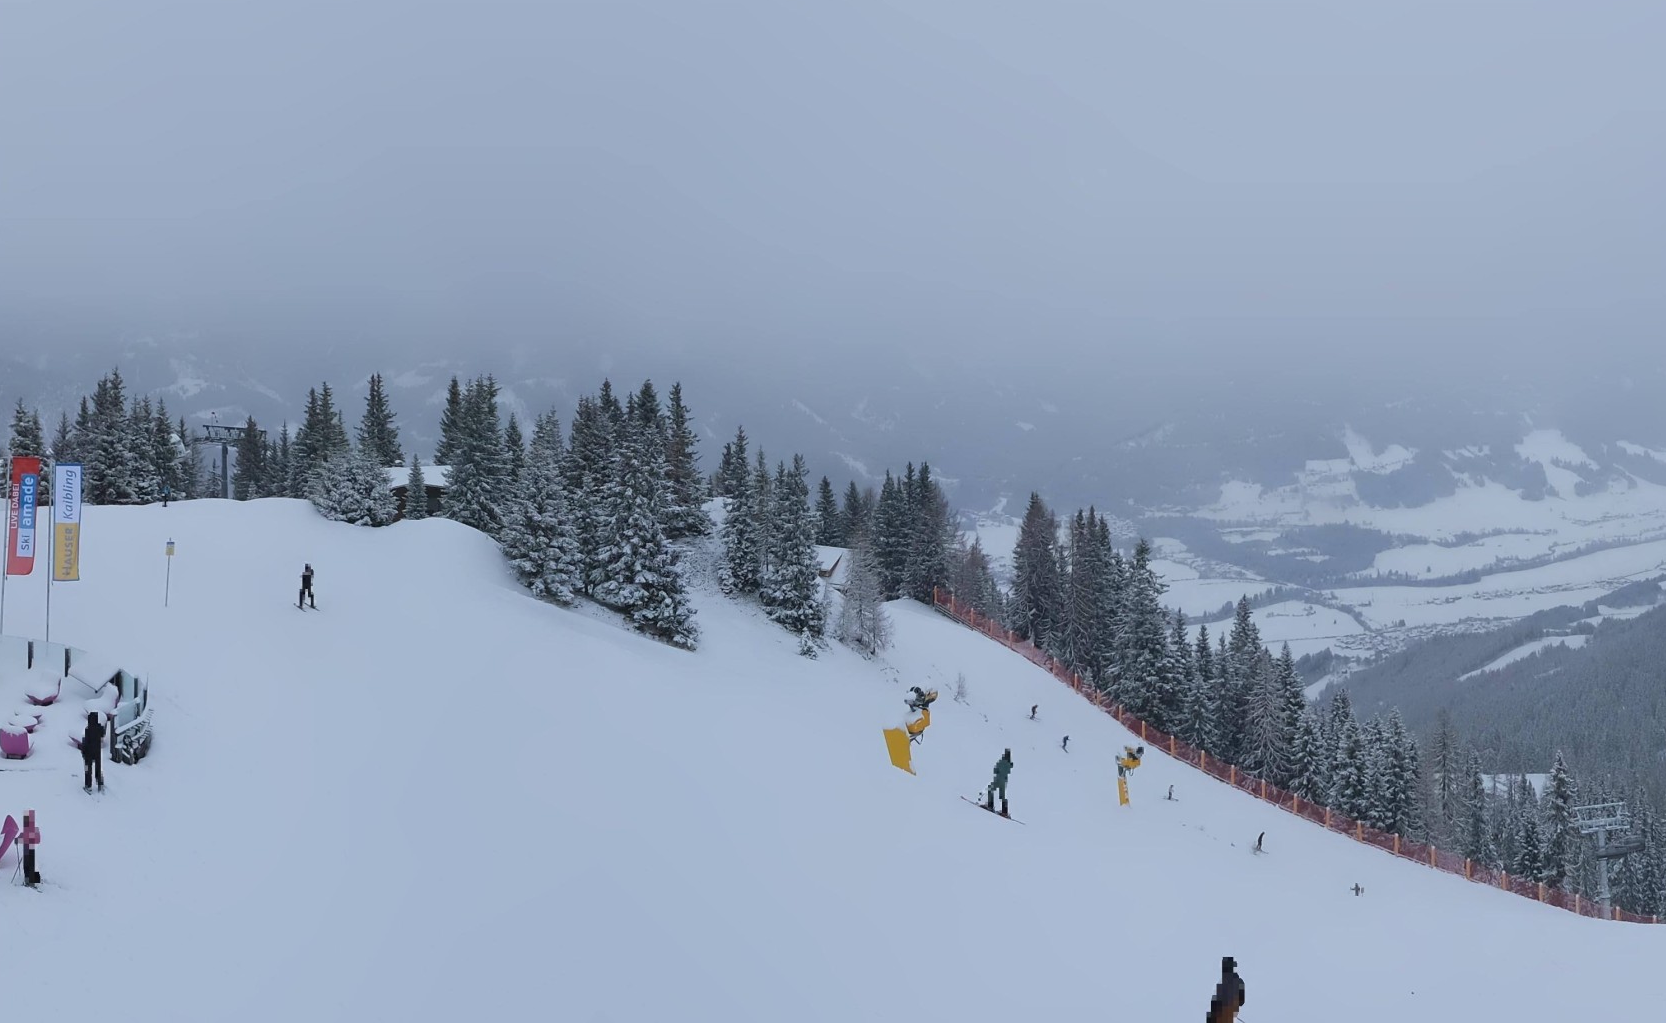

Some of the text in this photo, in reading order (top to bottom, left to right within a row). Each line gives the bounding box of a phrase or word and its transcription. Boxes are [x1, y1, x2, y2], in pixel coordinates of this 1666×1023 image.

[12, 483, 20, 509] DABEI
[62, 469, 77, 576] HAUSER Kaibling
[21, 535, 30, 550] Ski
